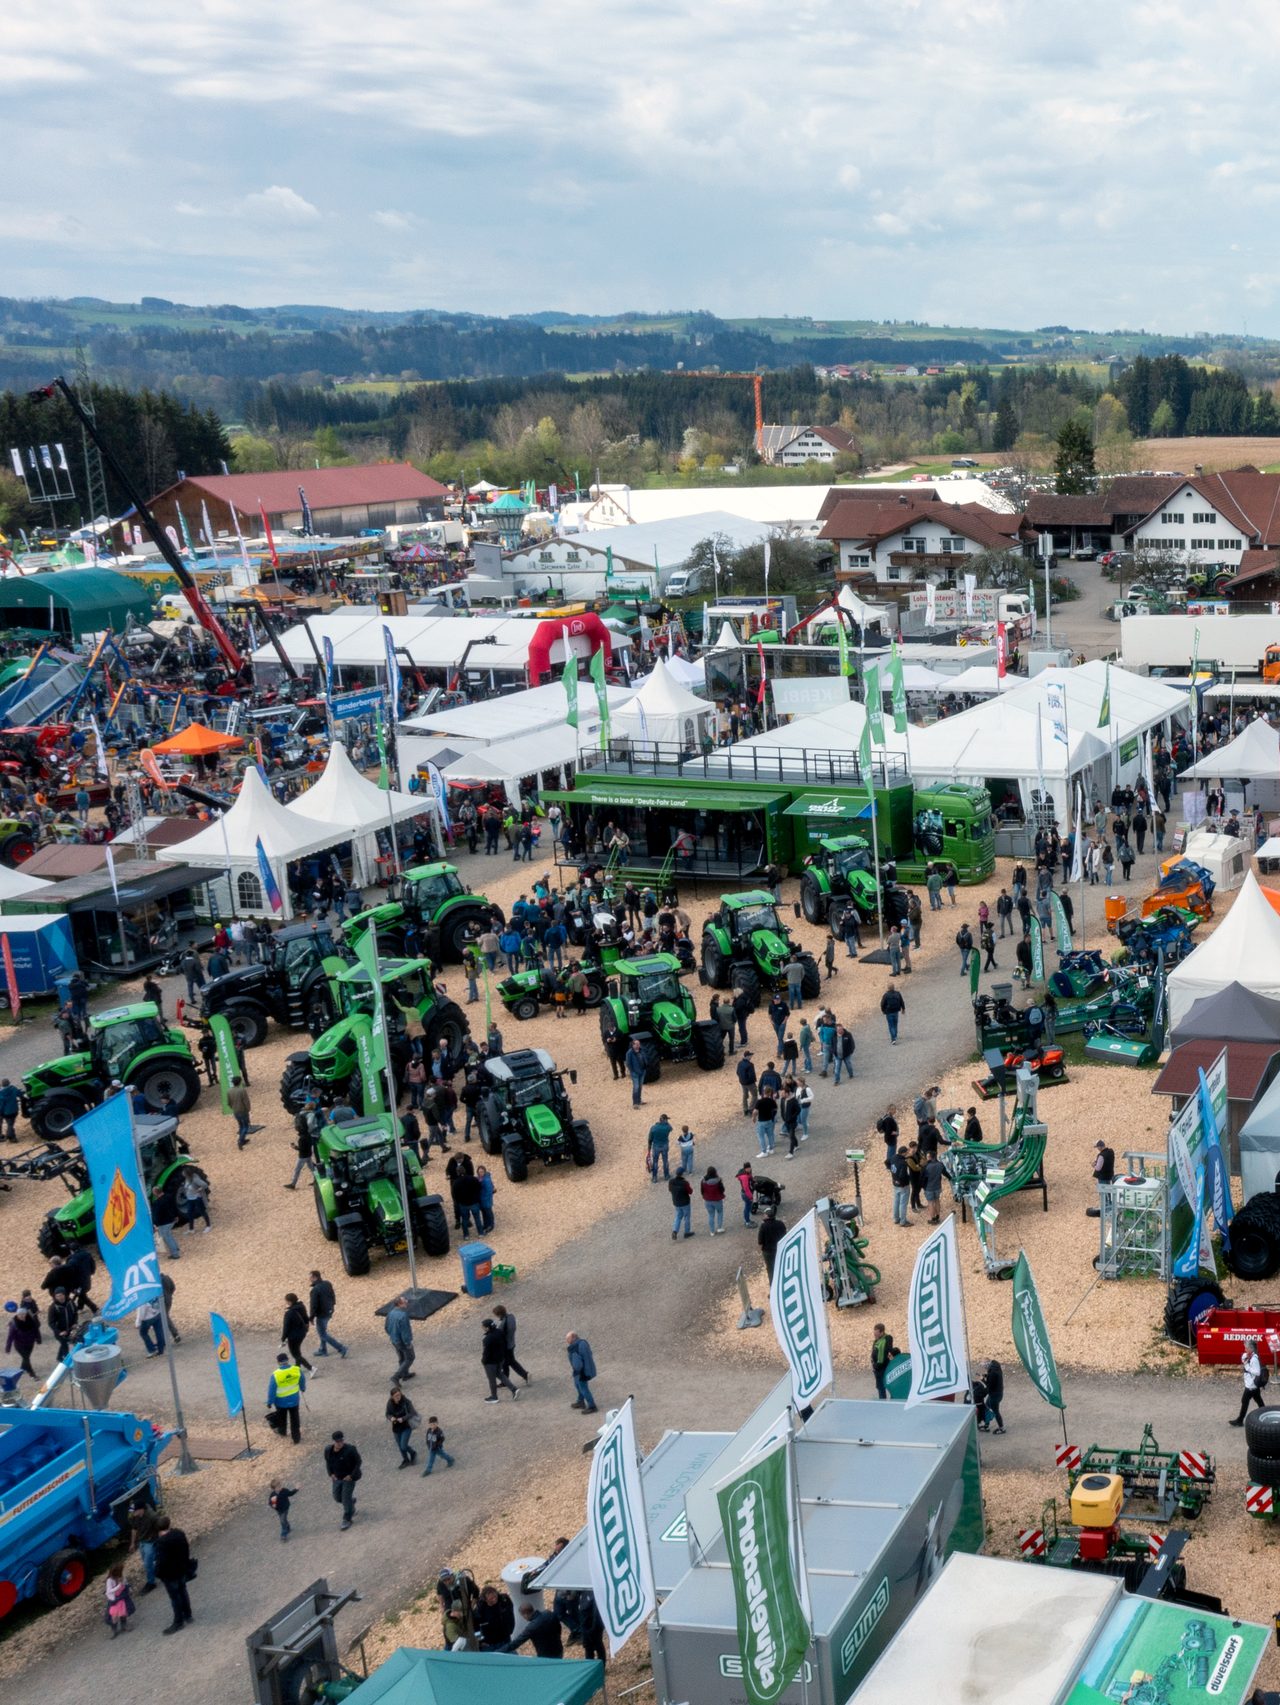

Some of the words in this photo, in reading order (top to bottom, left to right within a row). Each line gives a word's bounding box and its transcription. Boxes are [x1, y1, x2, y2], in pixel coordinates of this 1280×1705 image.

[591, 795, 608, 803] There
[608, 795, 614, 803] is
[619, 796, 634, 804] land
[1223, 1333, 1263, 1342] REDROCK
[12, 1472, 70, 1516] FUTTERMISCHER
[1210, 1636, 1239, 1693] düvelsdorf
